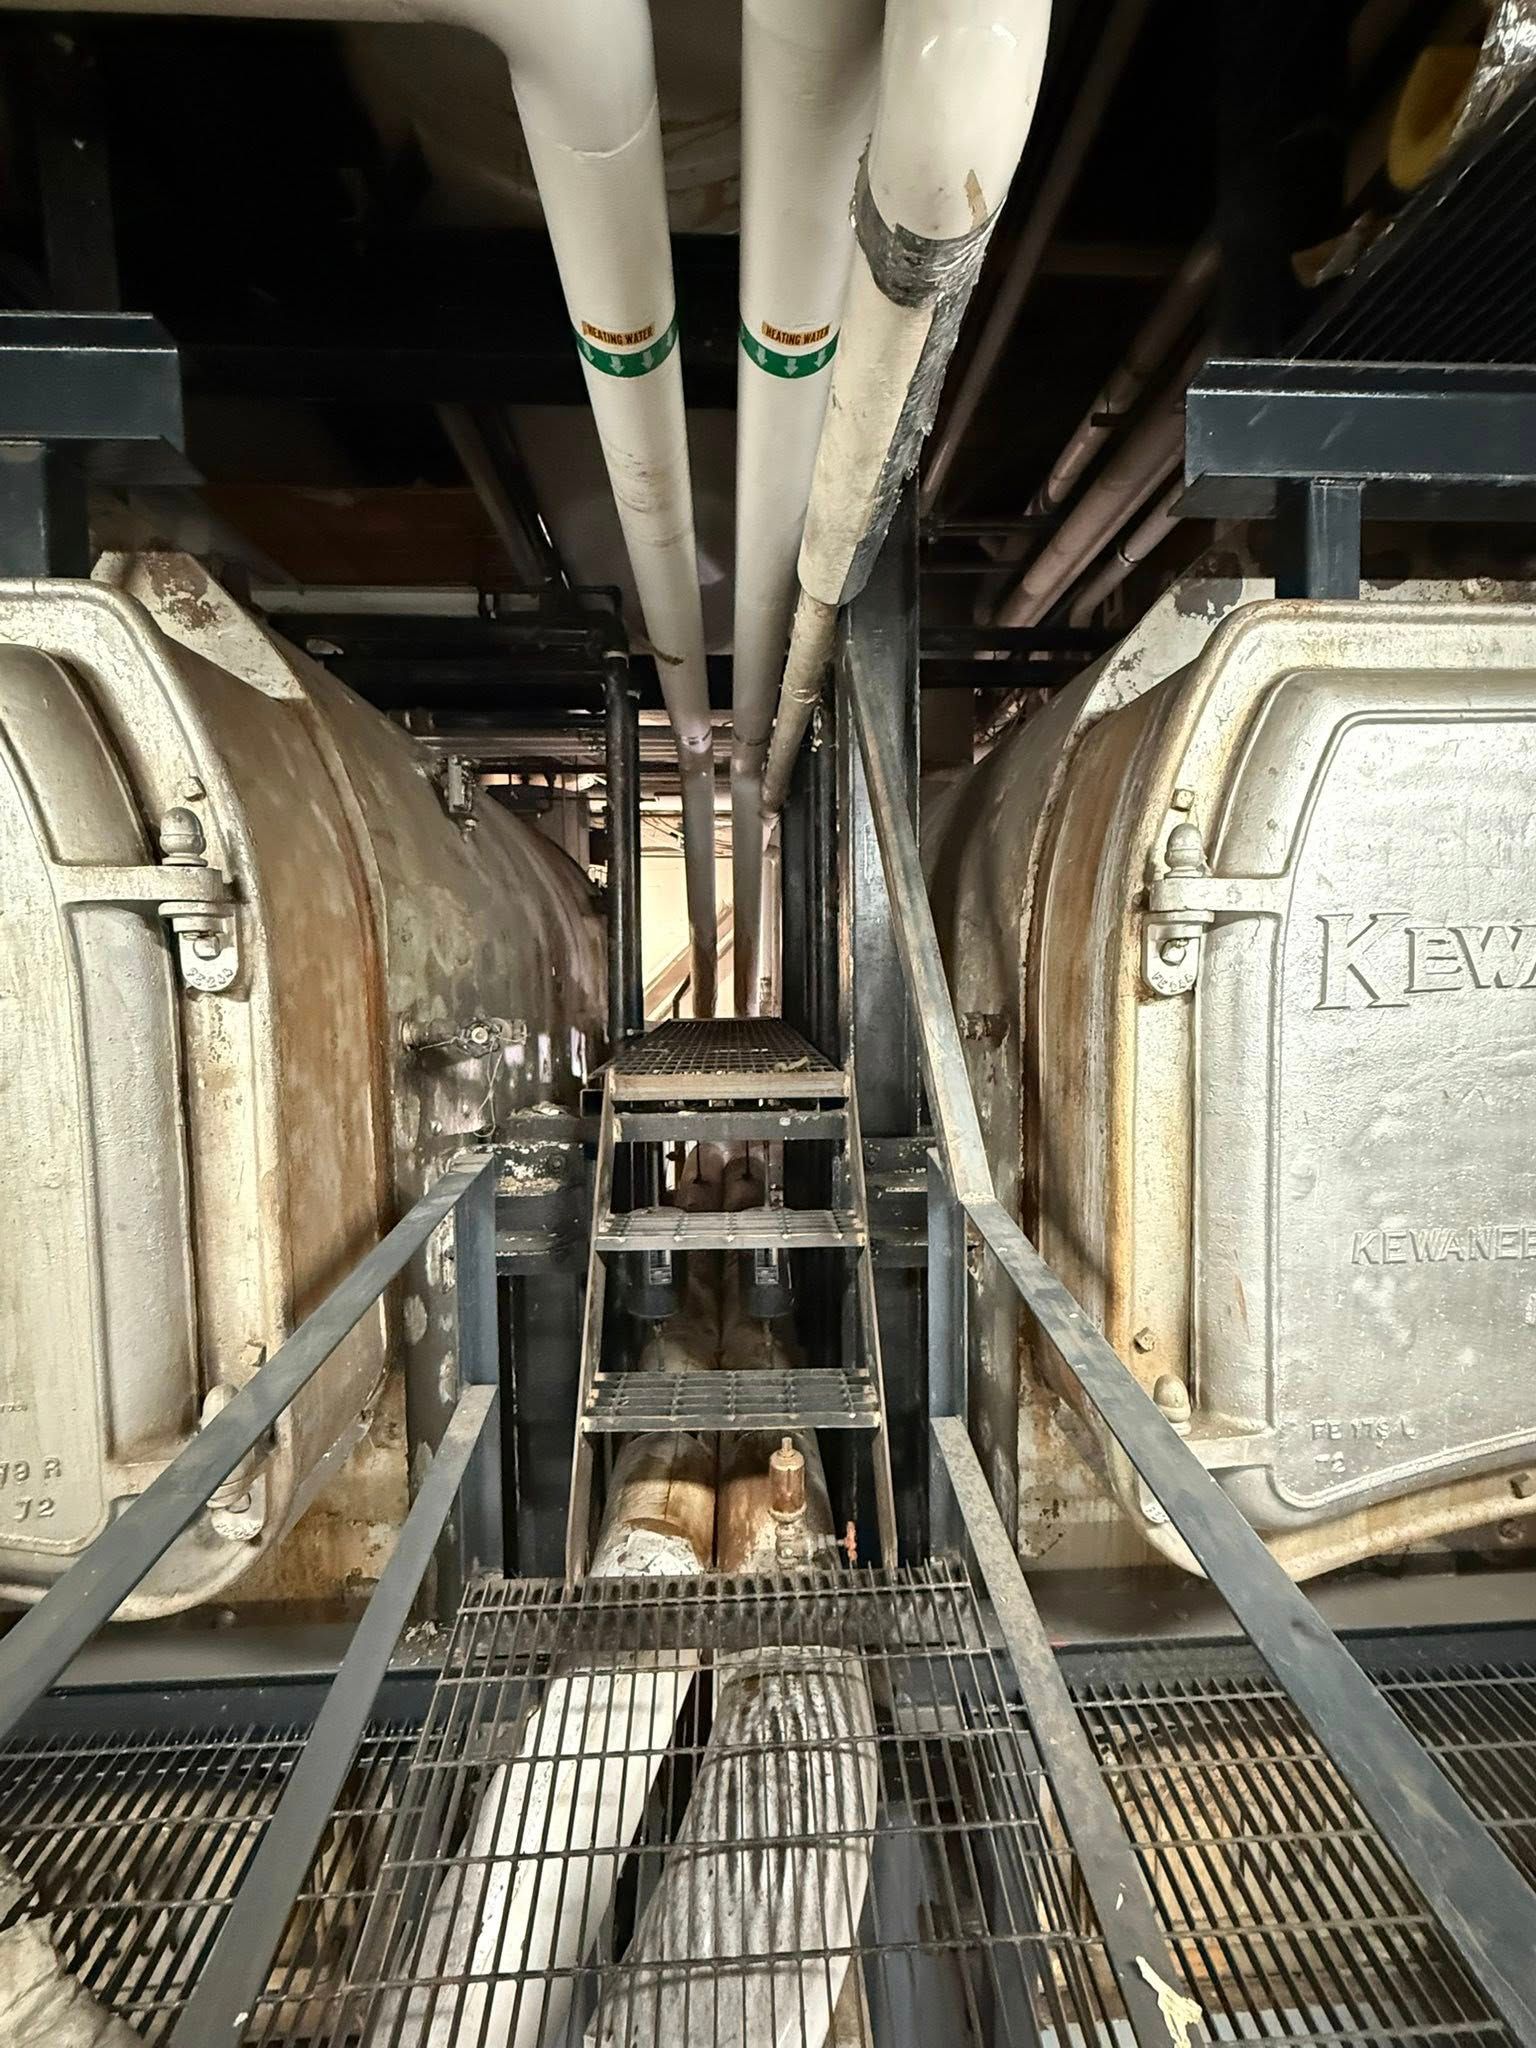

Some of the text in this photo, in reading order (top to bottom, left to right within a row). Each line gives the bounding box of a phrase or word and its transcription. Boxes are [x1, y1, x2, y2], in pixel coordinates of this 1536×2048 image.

[586, 324, 654, 345] HEATING WATER
[765, 324, 830, 345] HEATING WATER
[1351, 1225, 1536, 1264] KEWANEE
[1310, 1417, 1342, 1440] FE
[44, 1456, 62, 1480] R
